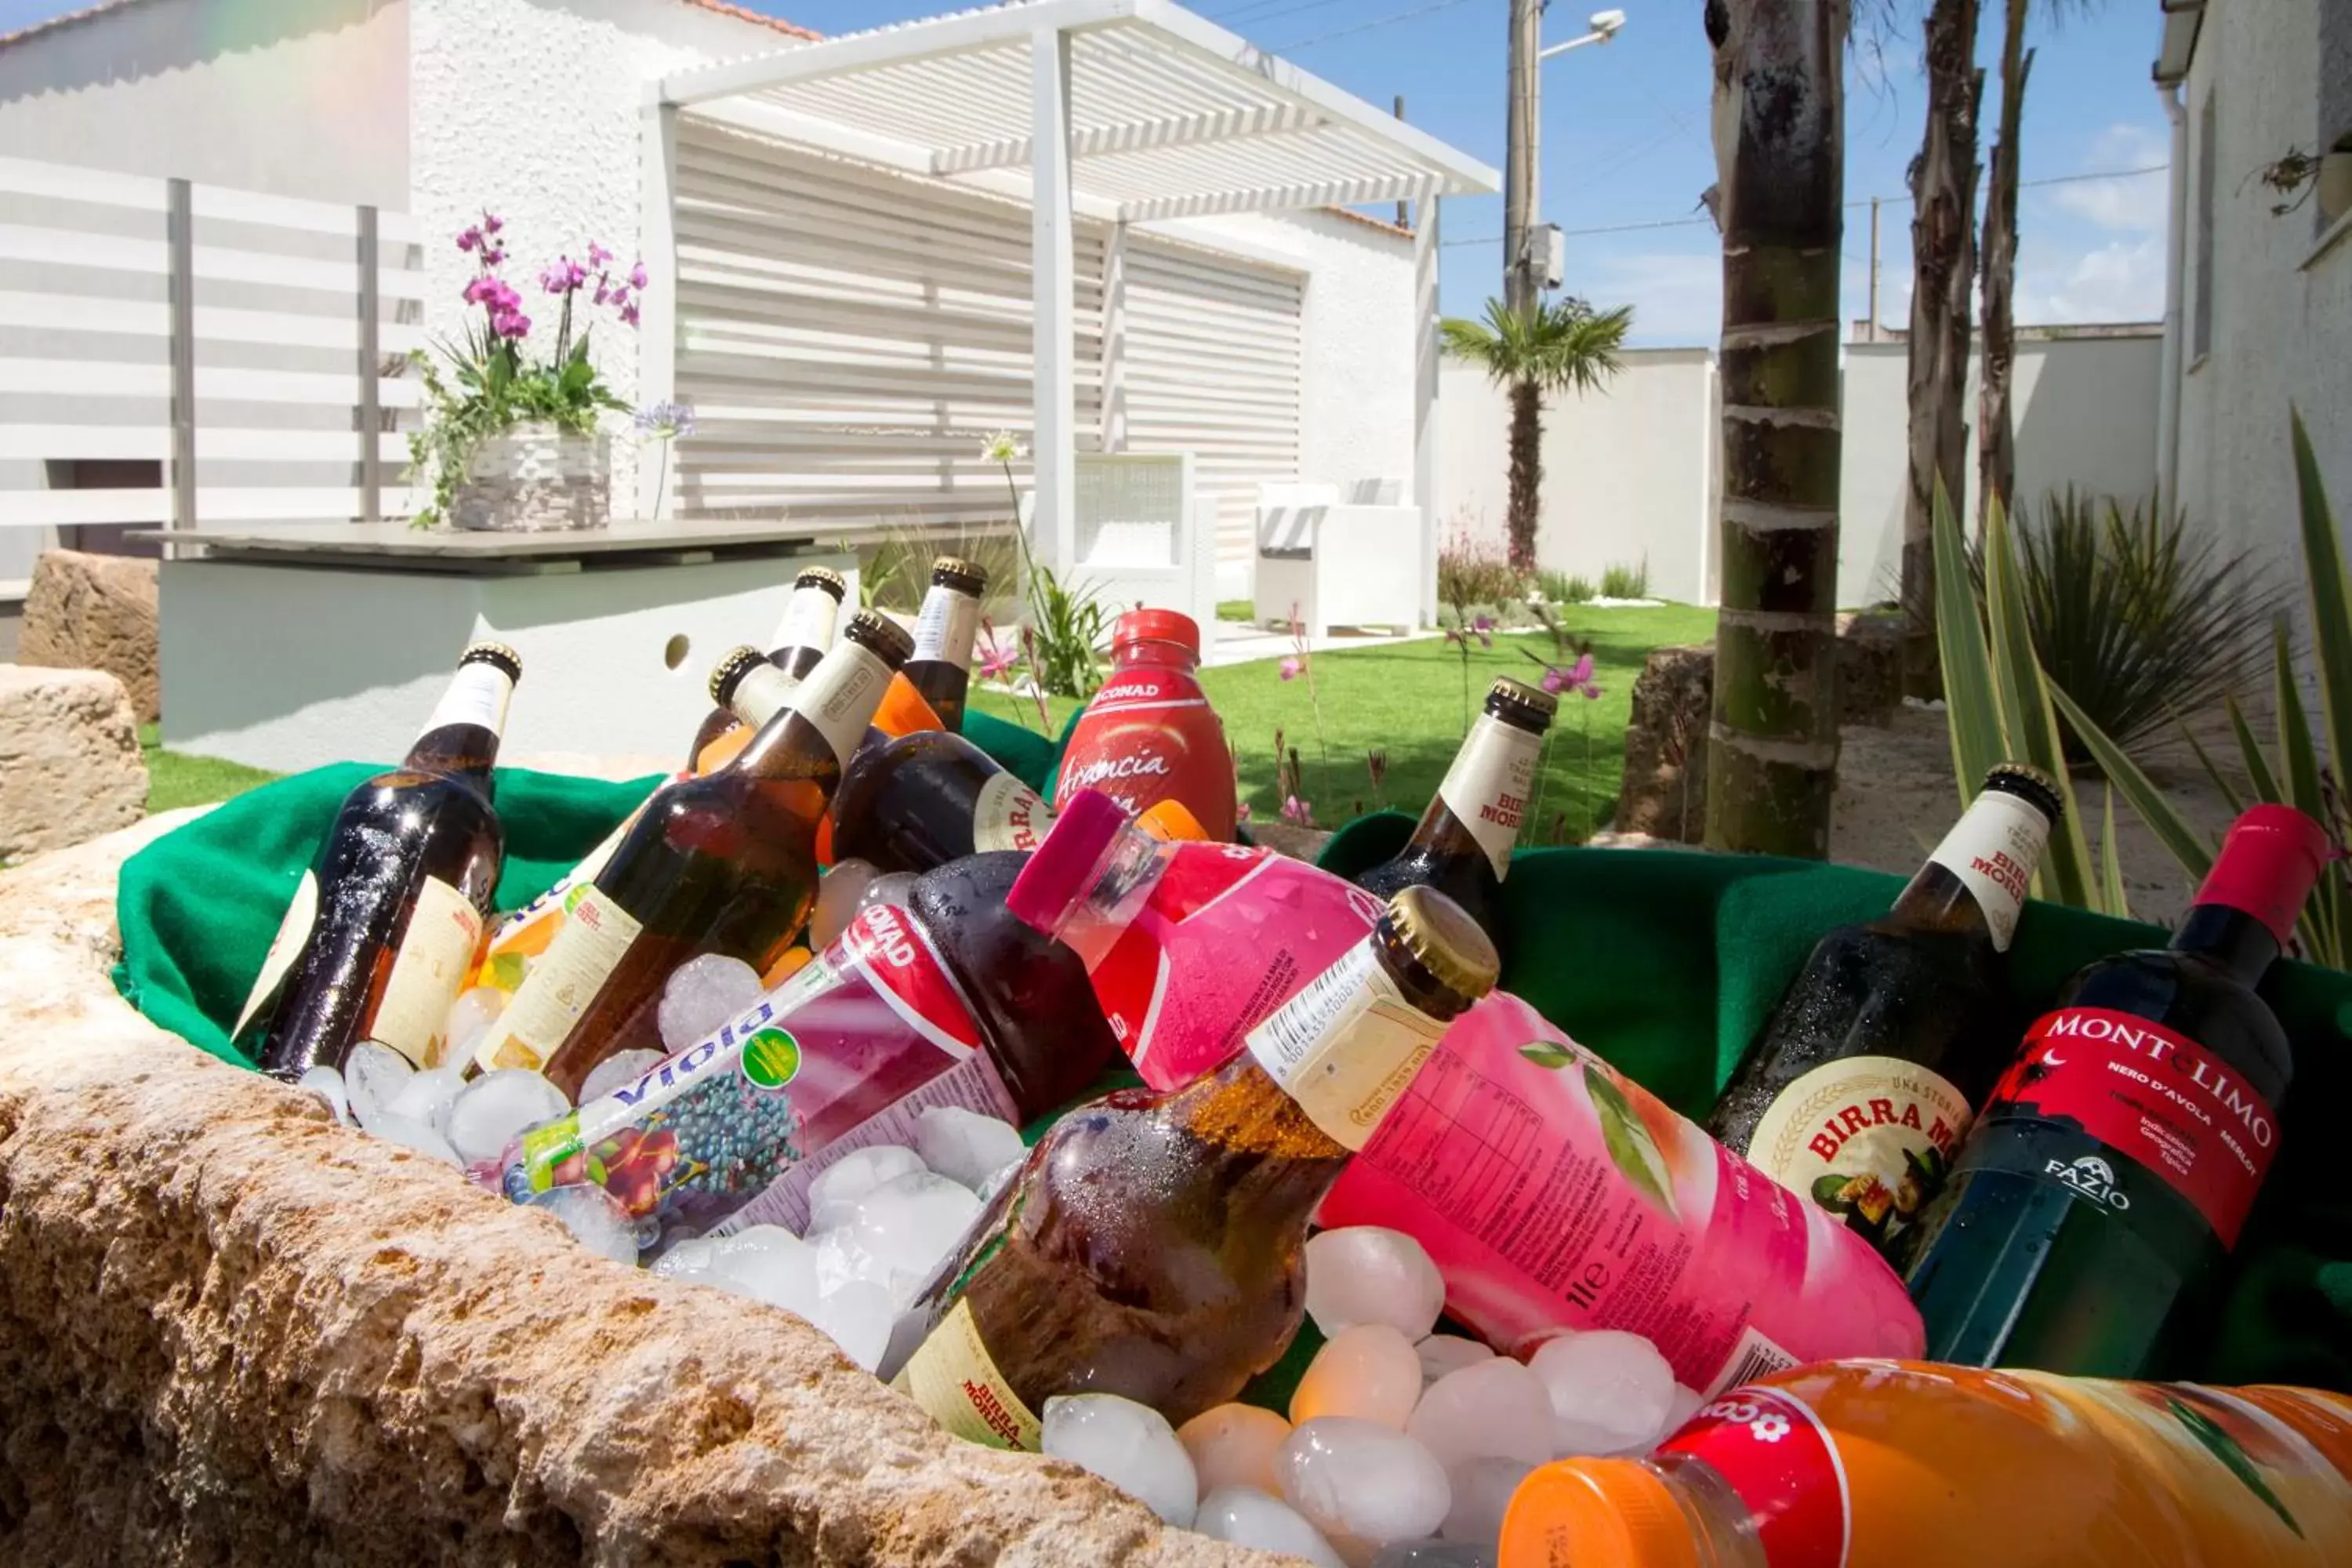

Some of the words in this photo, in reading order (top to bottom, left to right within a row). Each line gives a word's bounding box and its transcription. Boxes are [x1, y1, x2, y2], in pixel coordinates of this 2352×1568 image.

[1102, 683, 1159, 701] CONAD
[1058, 749, 1170, 799] Arancia
[2107, 1061, 2150, 1084] NERO
[2151, 1080, 2212, 1127] D'AVOLA
[1807, 1098, 1922, 1163] BIRRA
[2044, 1159, 2130, 1210] FAZIO
[979, 1383, 1021, 1438] BIRRA
